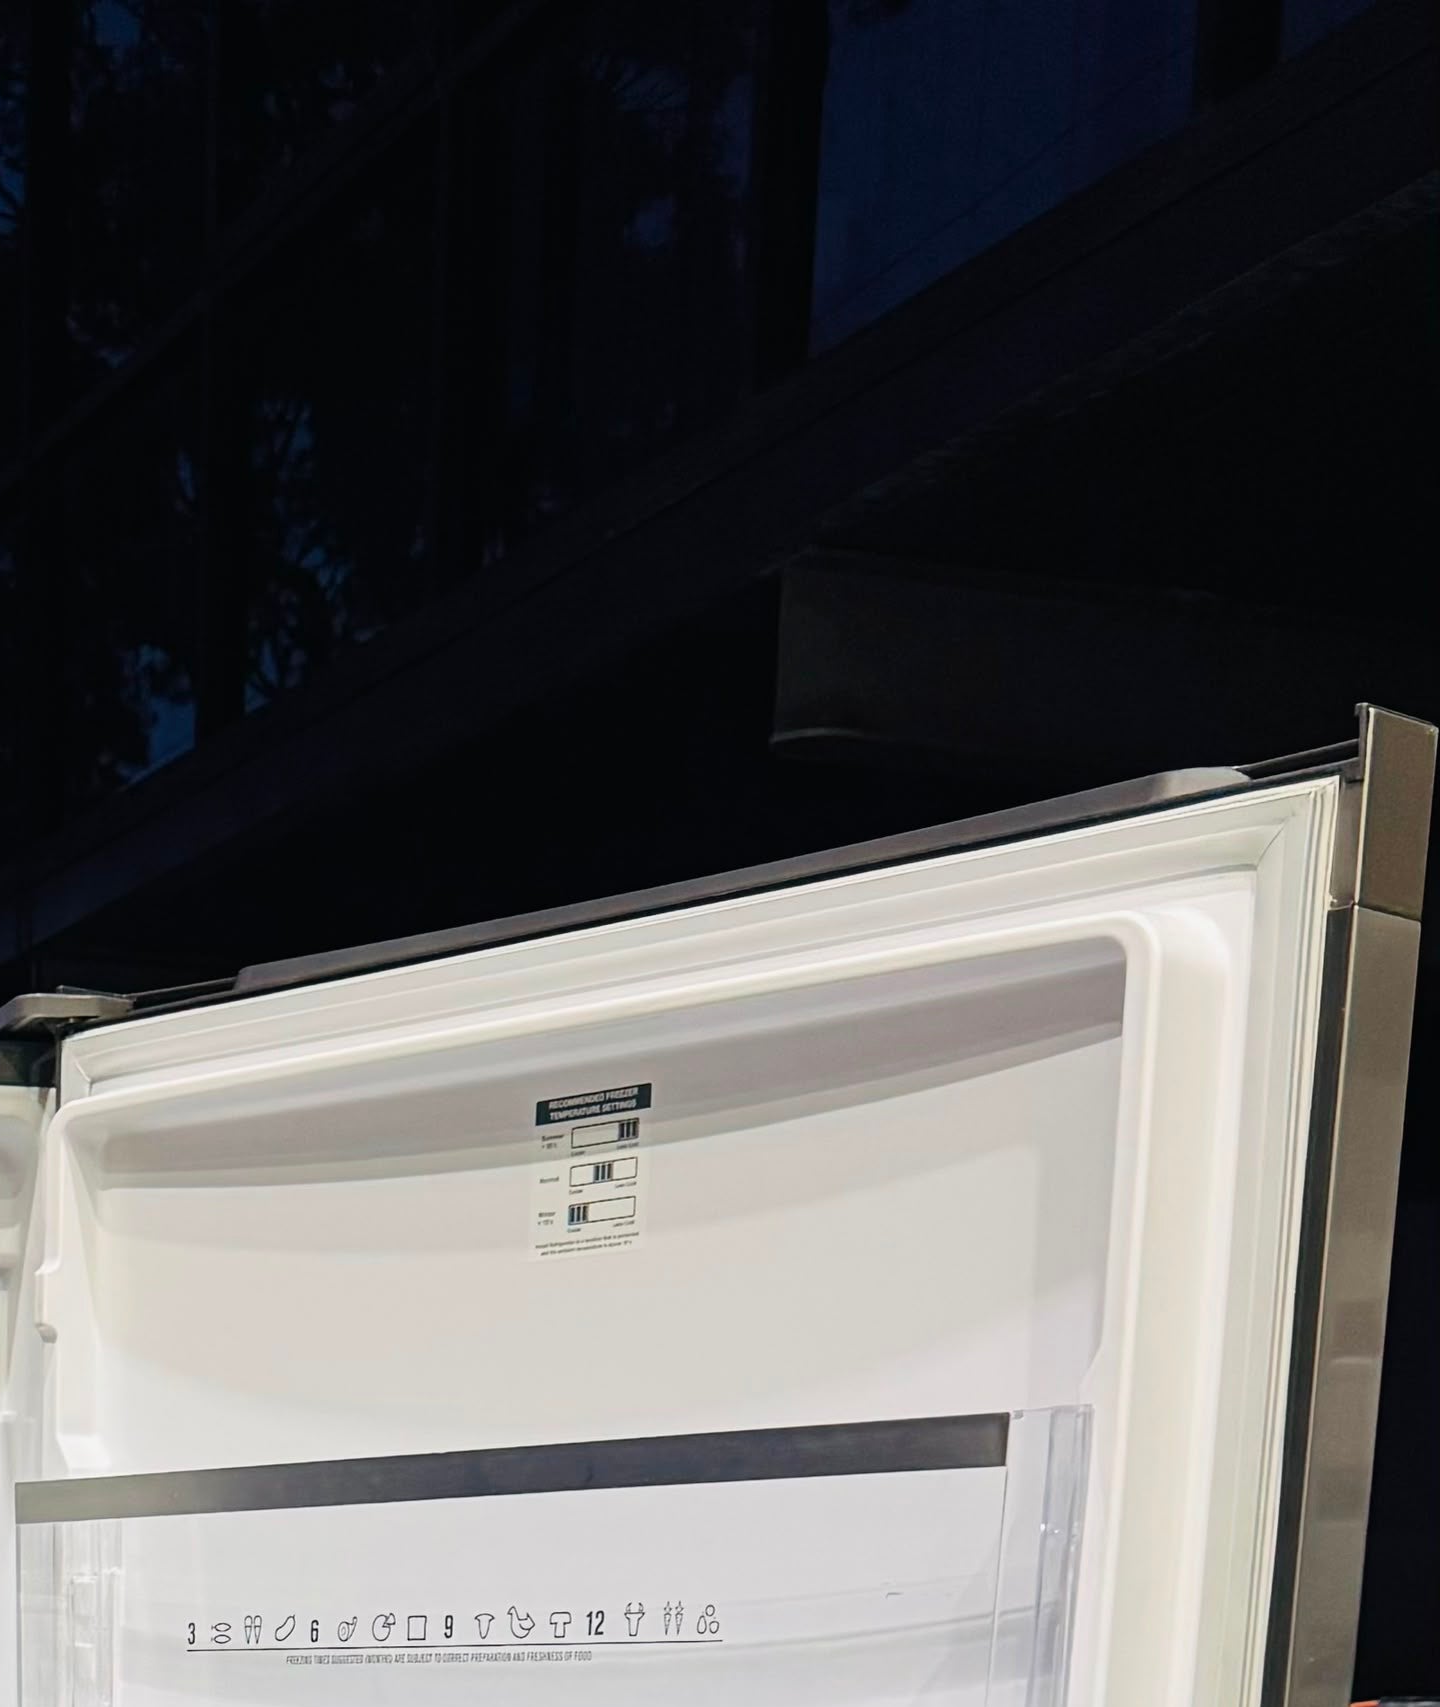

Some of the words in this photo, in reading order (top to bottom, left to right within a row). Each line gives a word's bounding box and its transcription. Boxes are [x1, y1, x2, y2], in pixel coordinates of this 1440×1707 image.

[606, 1087, 639, 1100] FREEZER
[550, 1105, 601, 1120] TEMPERATURE
[187, 1622, 196, 1645] 3
[310, 1619, 319, 1643] 6
[444, 1615, 454, 1639] 9
[586, 1610, 605, 1636] 12
[470, 1652, 511, 1662] PREPARATION
[512, 1652, 525, 1662] AND
[527, 1651, 563, 1662] FRESHNESS
[564, 1651, 573, 1661] OF
[574, 1650, 592, 1661] FOOD
